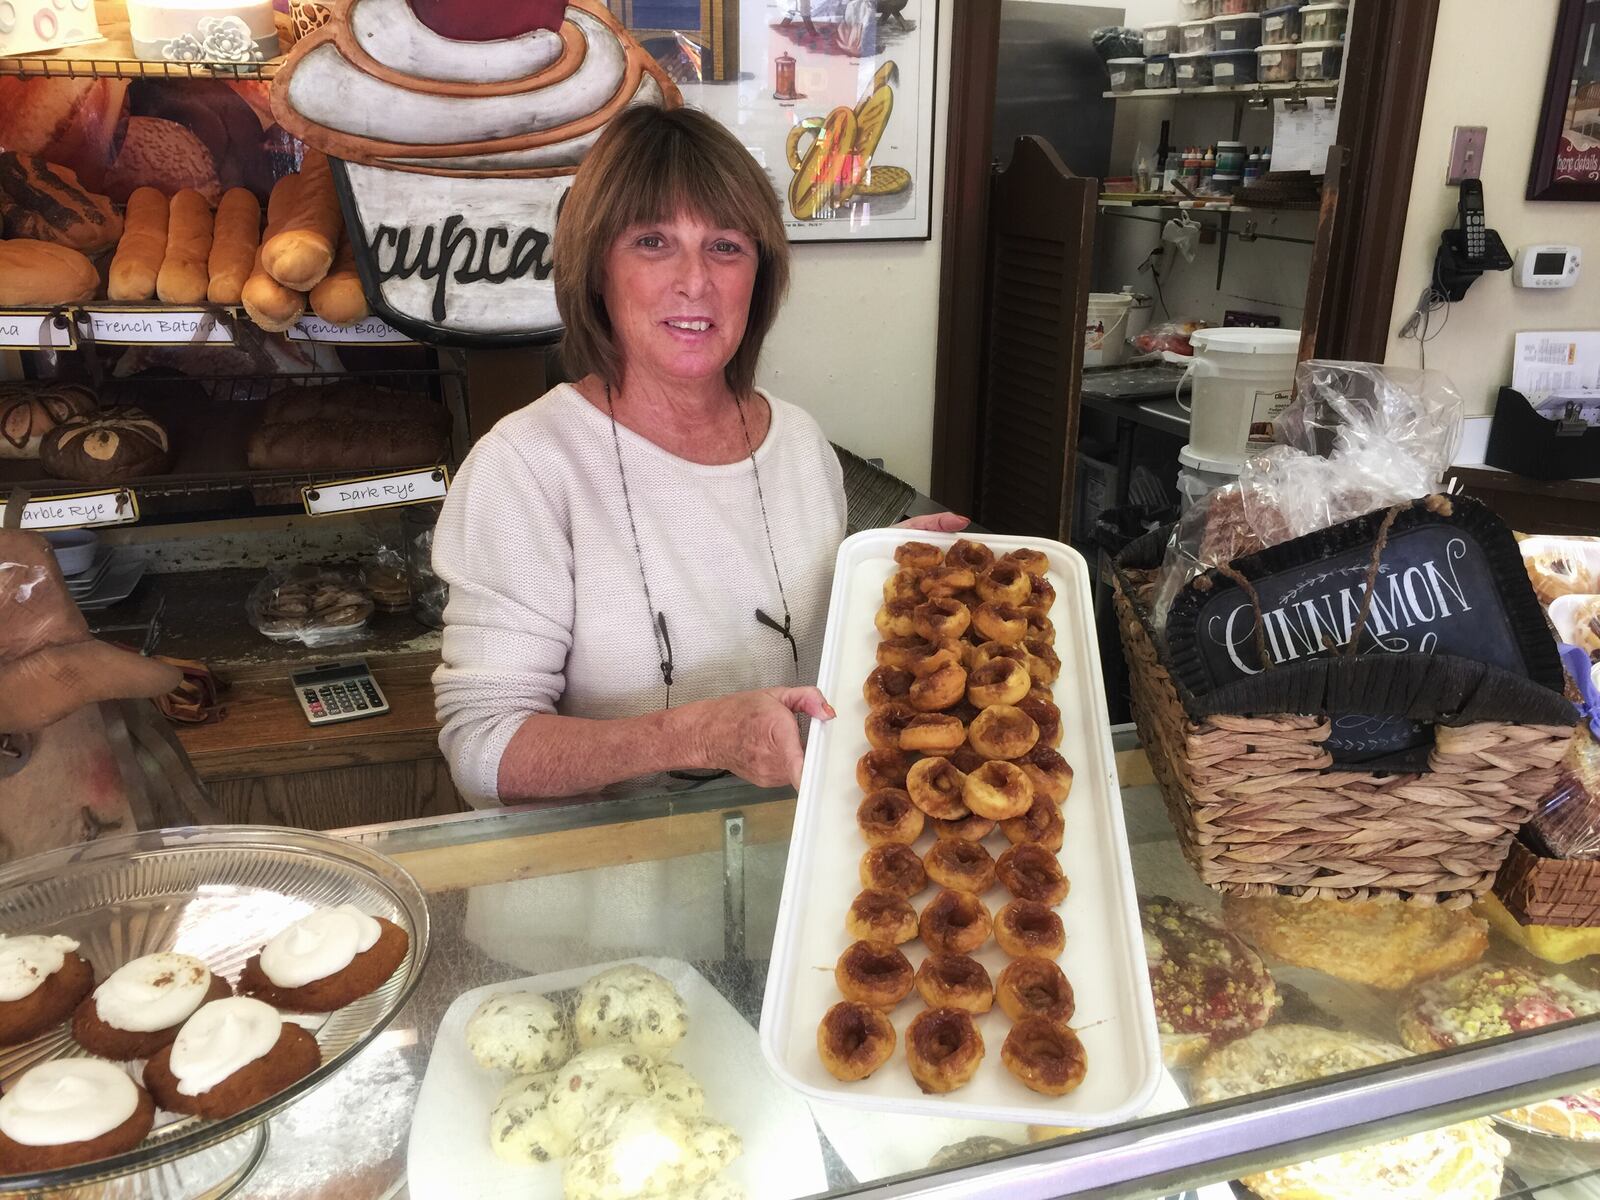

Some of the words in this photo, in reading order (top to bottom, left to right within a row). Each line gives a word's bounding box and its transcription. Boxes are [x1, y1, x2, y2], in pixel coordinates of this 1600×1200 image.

[371, 186, 570, 322] cupca
[94, 319, 152, 332] French
[157, 319, 218, 333] Batard
[340, 487, 380, 501] Dark
[383, 482, 416, 499] Rye
[22, 507, 64, 519] arble
[68, 503, 105, 521] Rye
[1207, 538, 1473, 675] CINNAMON
